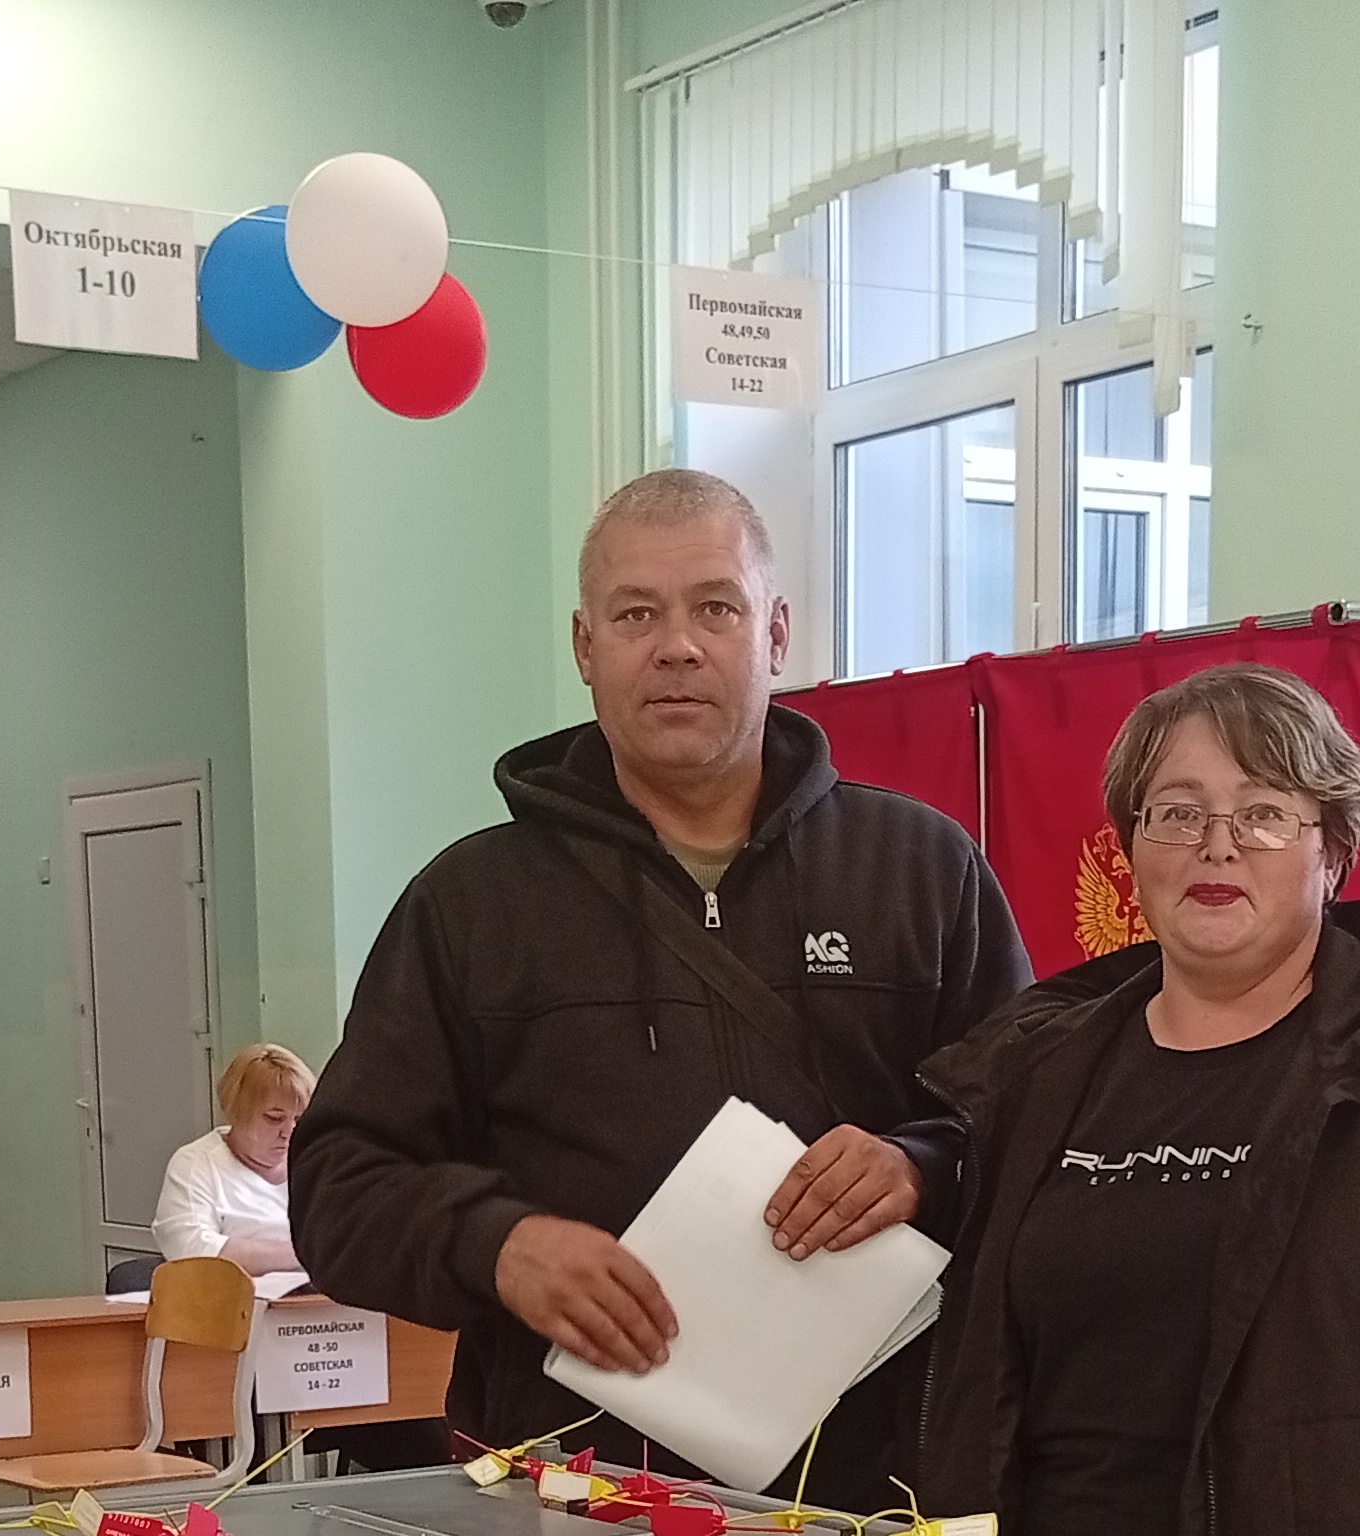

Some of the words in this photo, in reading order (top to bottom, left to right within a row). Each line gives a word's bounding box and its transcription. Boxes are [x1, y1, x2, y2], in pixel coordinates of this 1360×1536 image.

[24, 221, 182, 259] Октябрьская
[77, 266, 136, 298] 1-10
[688, 293, 803, 320] Первомайская
[721, 323, 770, 340] 48,49,50
[705, 346, 787, 370] Советская
[731, 377, 764, 393] 14-22
[278, 1321, 365, 1337] ПЕРВОМАЙСКАЯ
[307, 1343, 320, 1352] 48
[294, 1359, 353, 1373] СОВЕТСКАЯ
